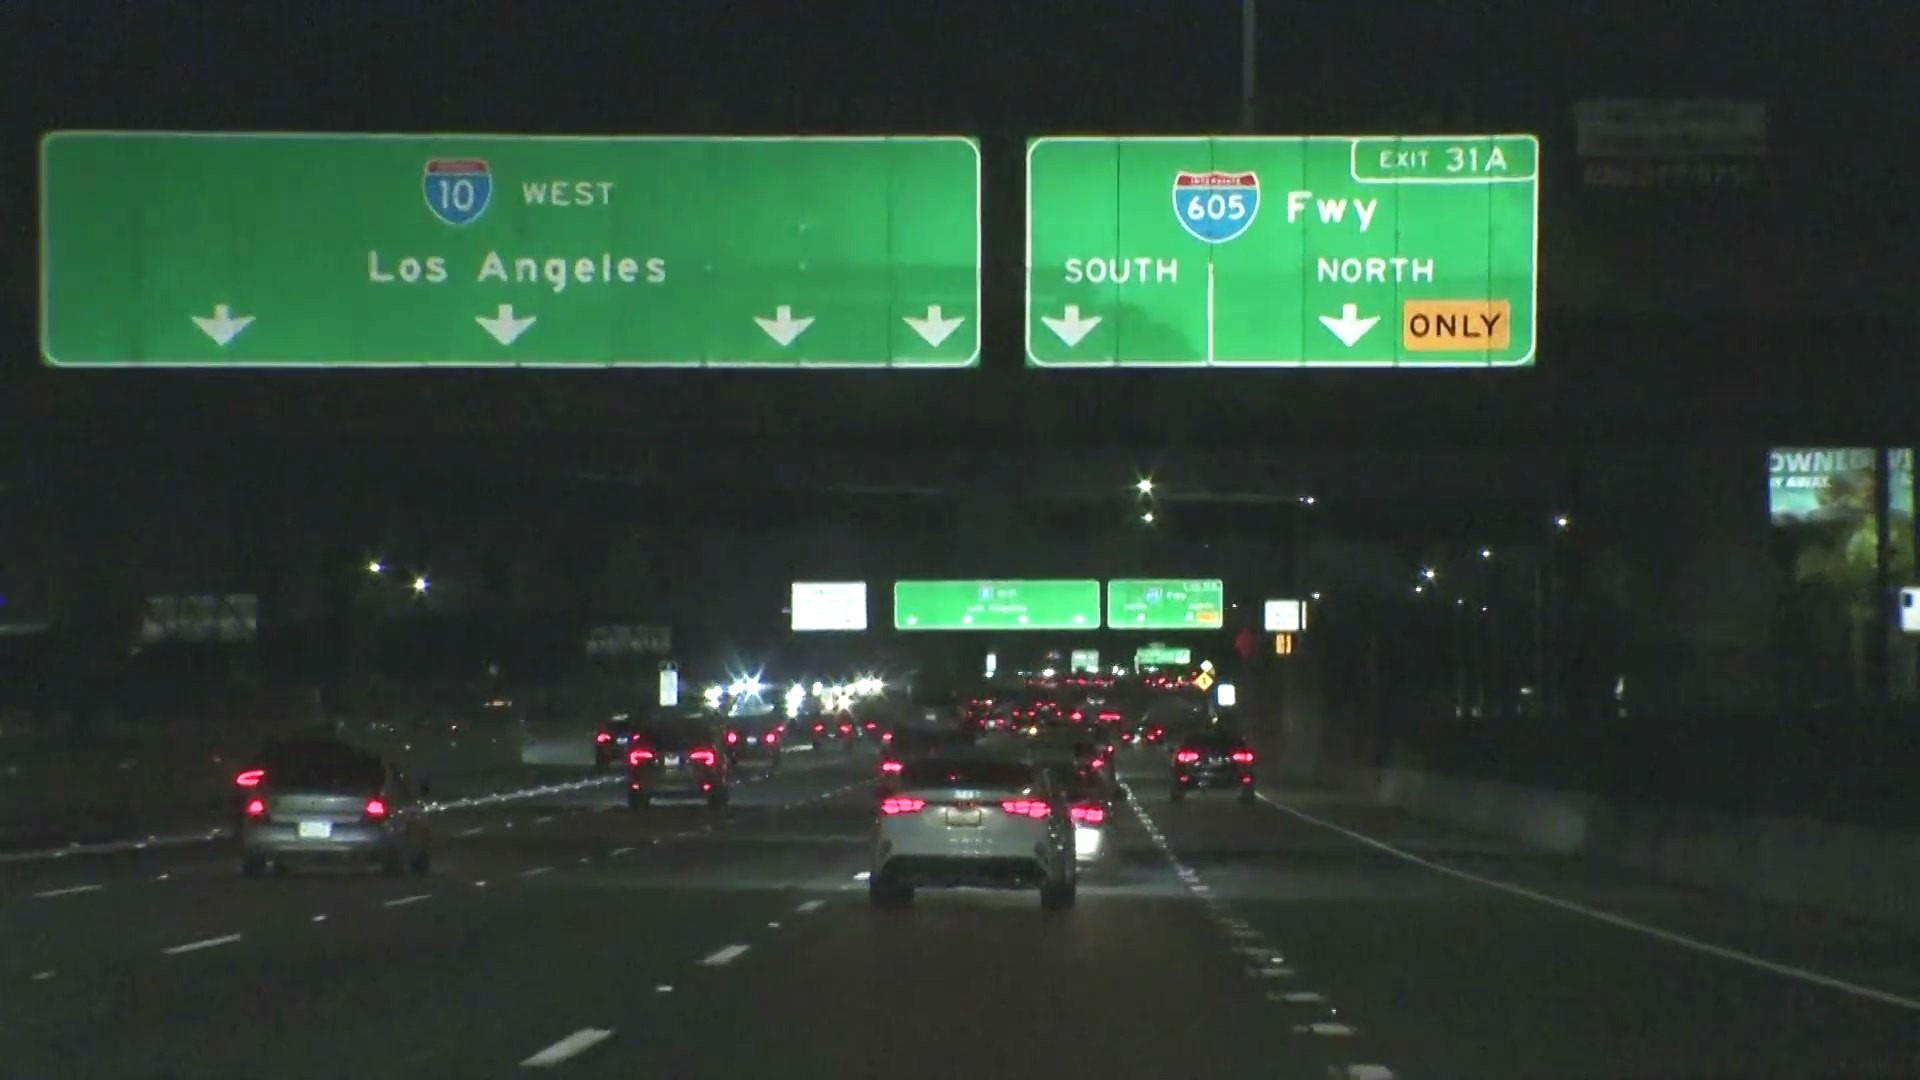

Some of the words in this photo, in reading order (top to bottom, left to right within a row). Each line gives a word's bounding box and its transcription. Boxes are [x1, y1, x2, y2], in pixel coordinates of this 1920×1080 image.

[1379, 149, 1429, 169] EXIT
[1444, 146, 1509, 173] 31A
[439, 178, 475, 212] 10
[522, 181, 613, 206] WEST
[1187, 193, 1246, 221] 605
[1287, 192, 1377, 232] Fwy
[369, 251, 448, 283] Los
[479, 251, 666, 293] Angeles
[1064, 257, 1178, 284] SOUTH
[1317, 257, 1434, 284] NORTH
[1409, 313, 1501, 339] ONLY
